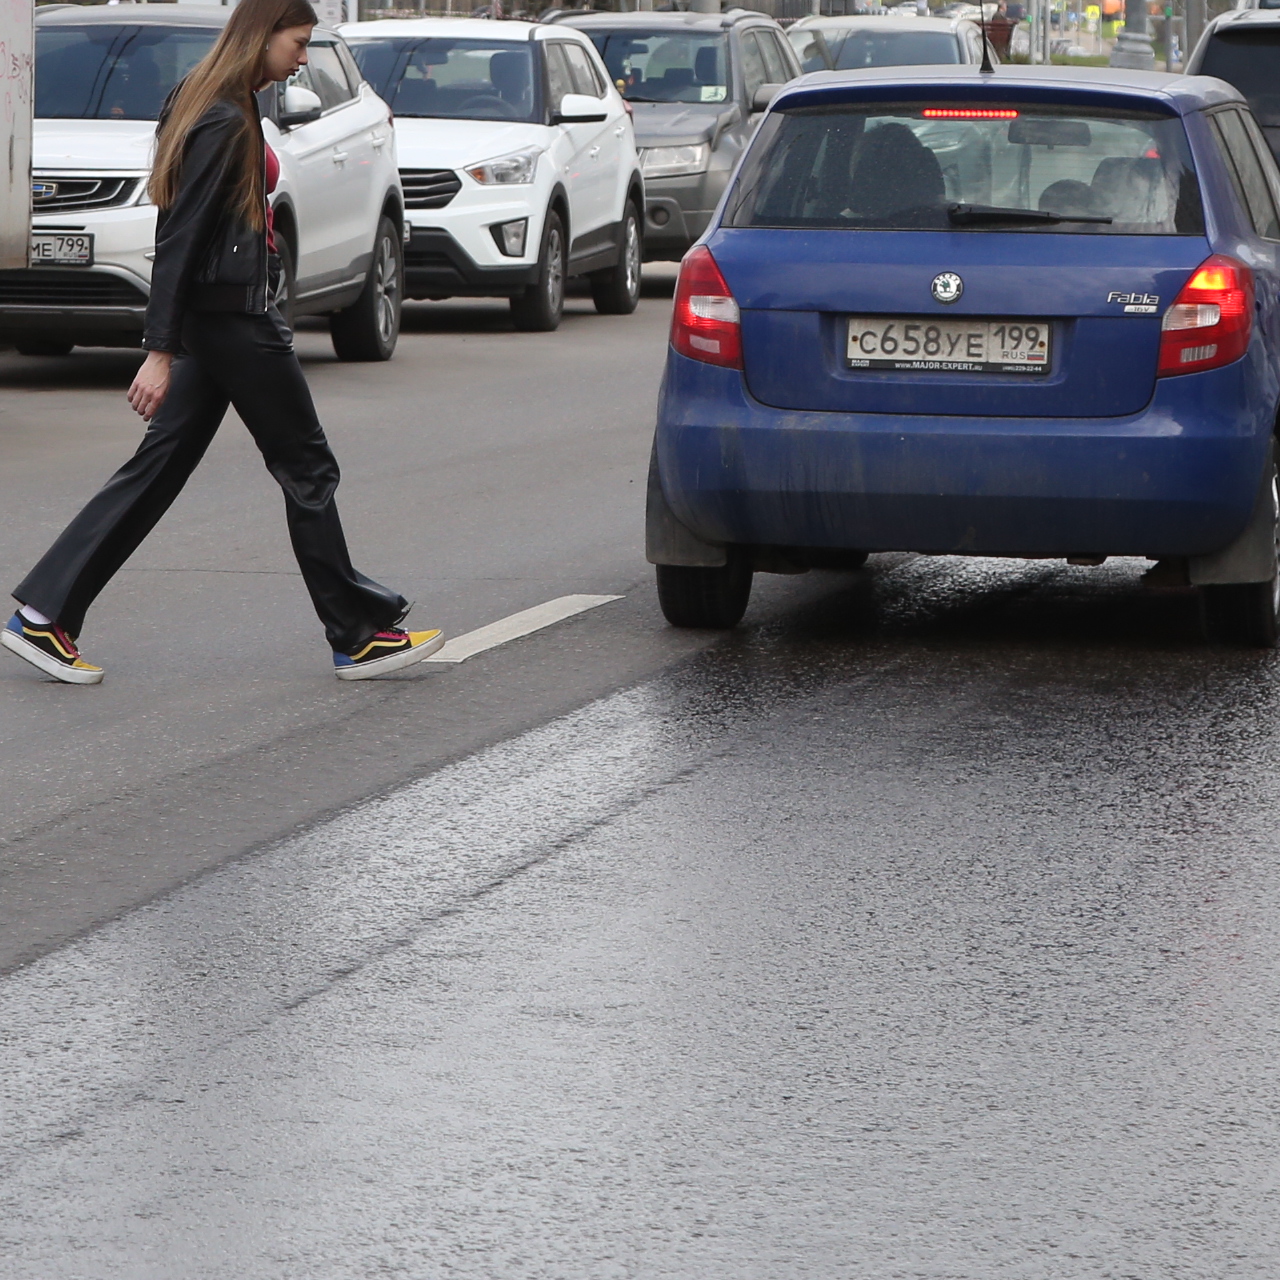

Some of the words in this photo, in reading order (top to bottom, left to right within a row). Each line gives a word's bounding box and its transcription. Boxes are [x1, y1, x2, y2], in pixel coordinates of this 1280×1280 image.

[57, 237, 85, 252] 799
[1107, 291, 1160, 305] Fabia
[993, 324, 1040, 351] 199
[1002, 350, 1026, 360] RUS
